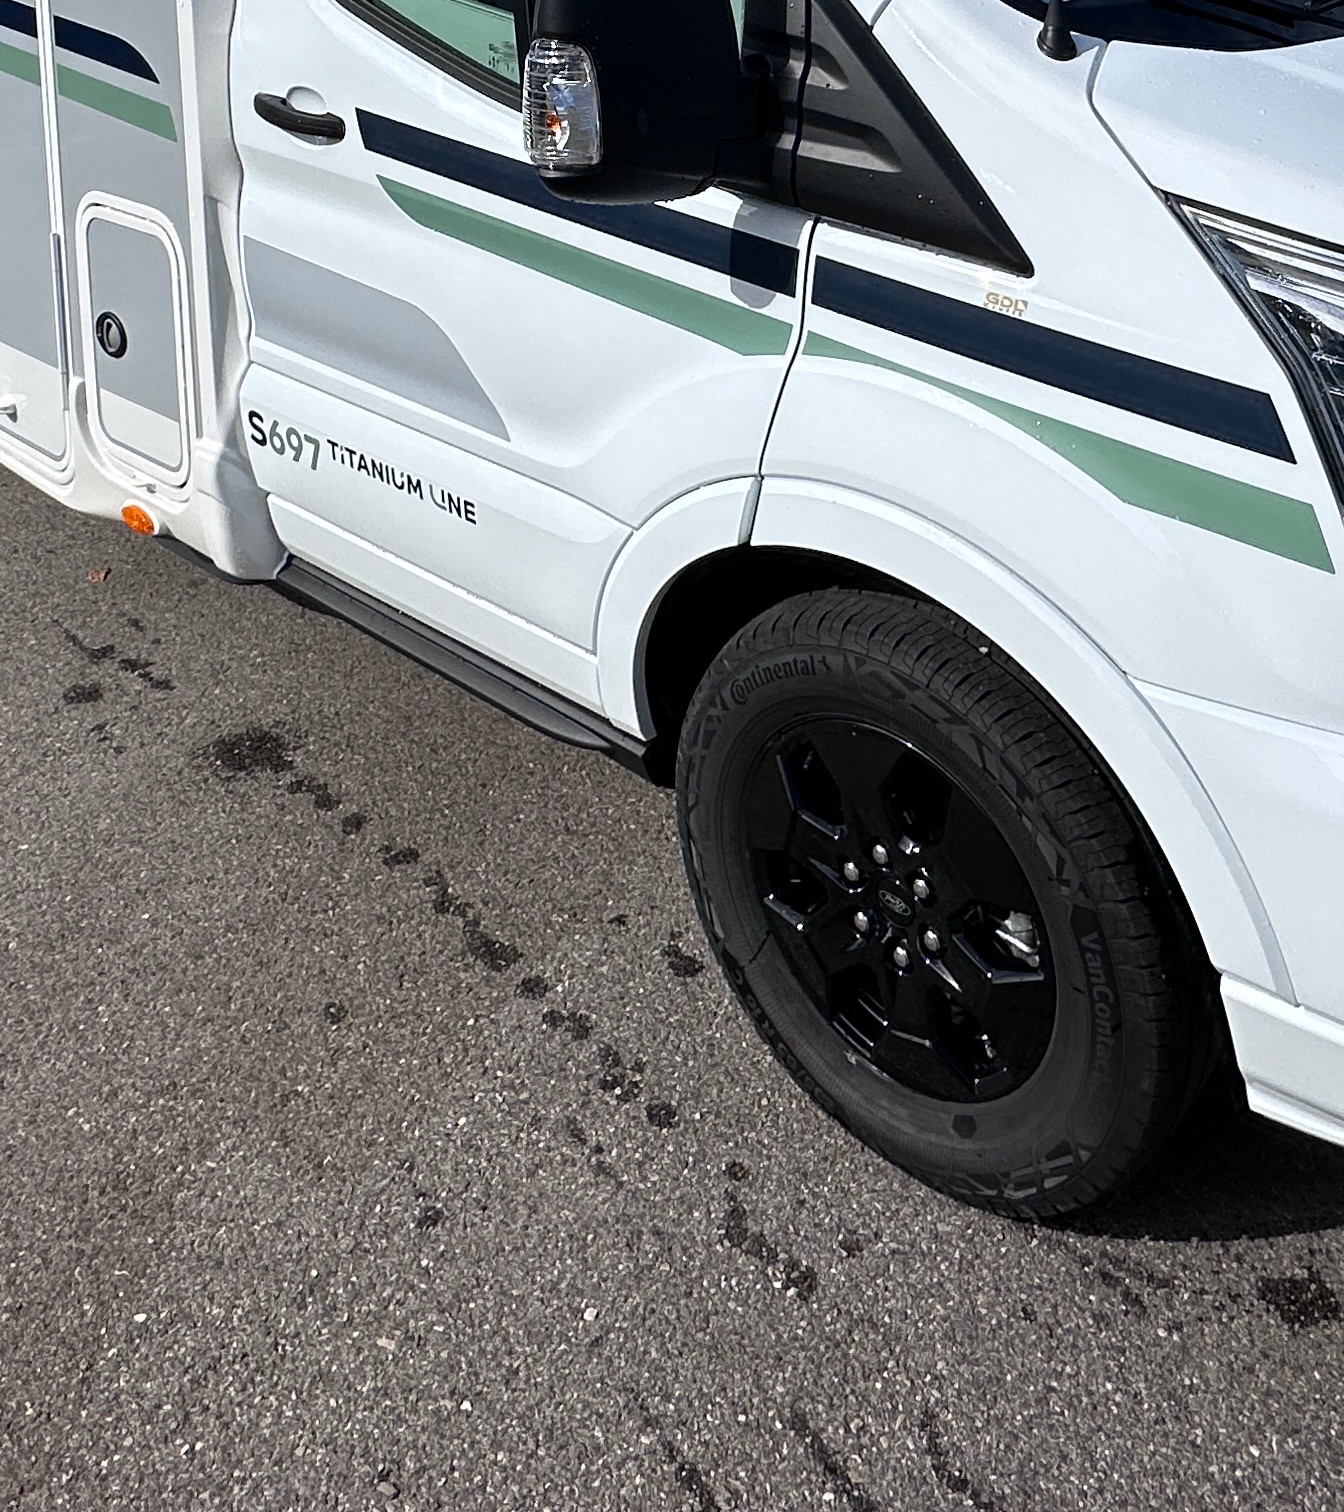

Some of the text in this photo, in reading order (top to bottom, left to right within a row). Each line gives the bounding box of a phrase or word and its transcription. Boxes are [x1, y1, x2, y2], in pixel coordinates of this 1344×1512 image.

[247, 409, 320, 471] S697
[429, 484, 477, 525] LINE
[729, 654, 817, 706] Continental
